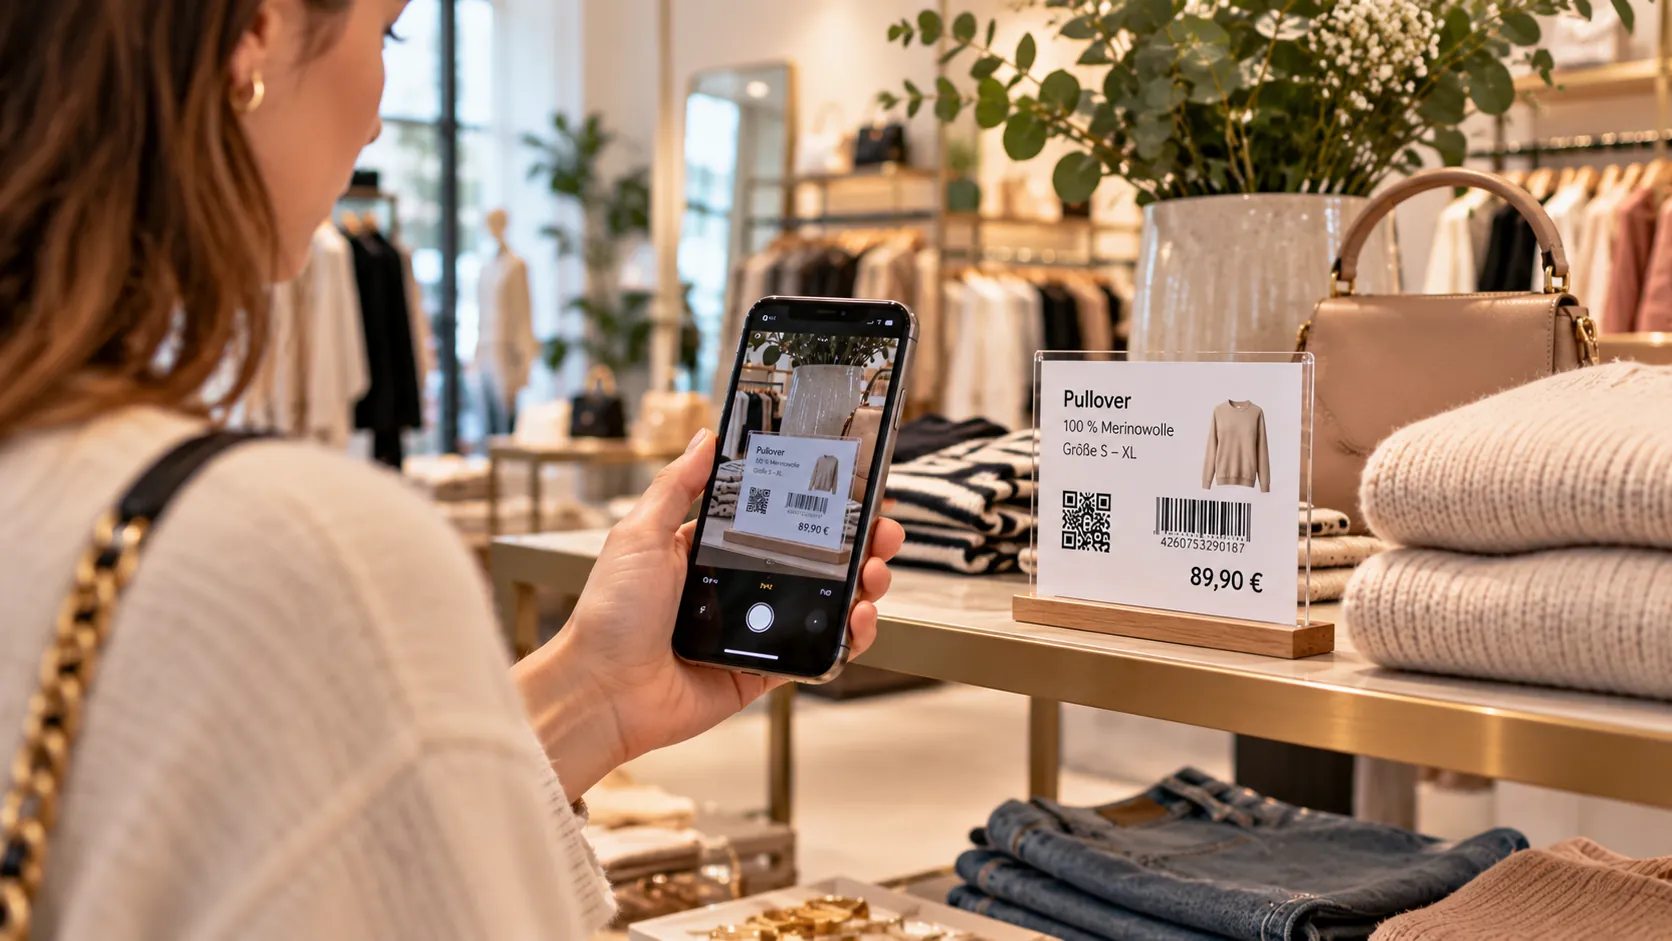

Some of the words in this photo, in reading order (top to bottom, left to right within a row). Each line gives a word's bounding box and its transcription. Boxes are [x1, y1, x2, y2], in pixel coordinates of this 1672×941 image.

[1063, 389, 1132, 409] Pullover
[1063, 419, 1084, 433] 100
[1087, 420, 1098, 433] %
[1101, 420, 1175, 437] Merinowolle
[756, 446, 785, 456] Pullover
[1062, 442, 1098, 457] Größe
[1100, 444, 1108, 458] S
[1121, 445, 1137, 460] XL
[823, 526, 830, 535] €
[1160, 537, 1245, 553] 4260753290187
[1190, 566, 1244, 592] 89,90
[1249, 572, 1263, 593] €
